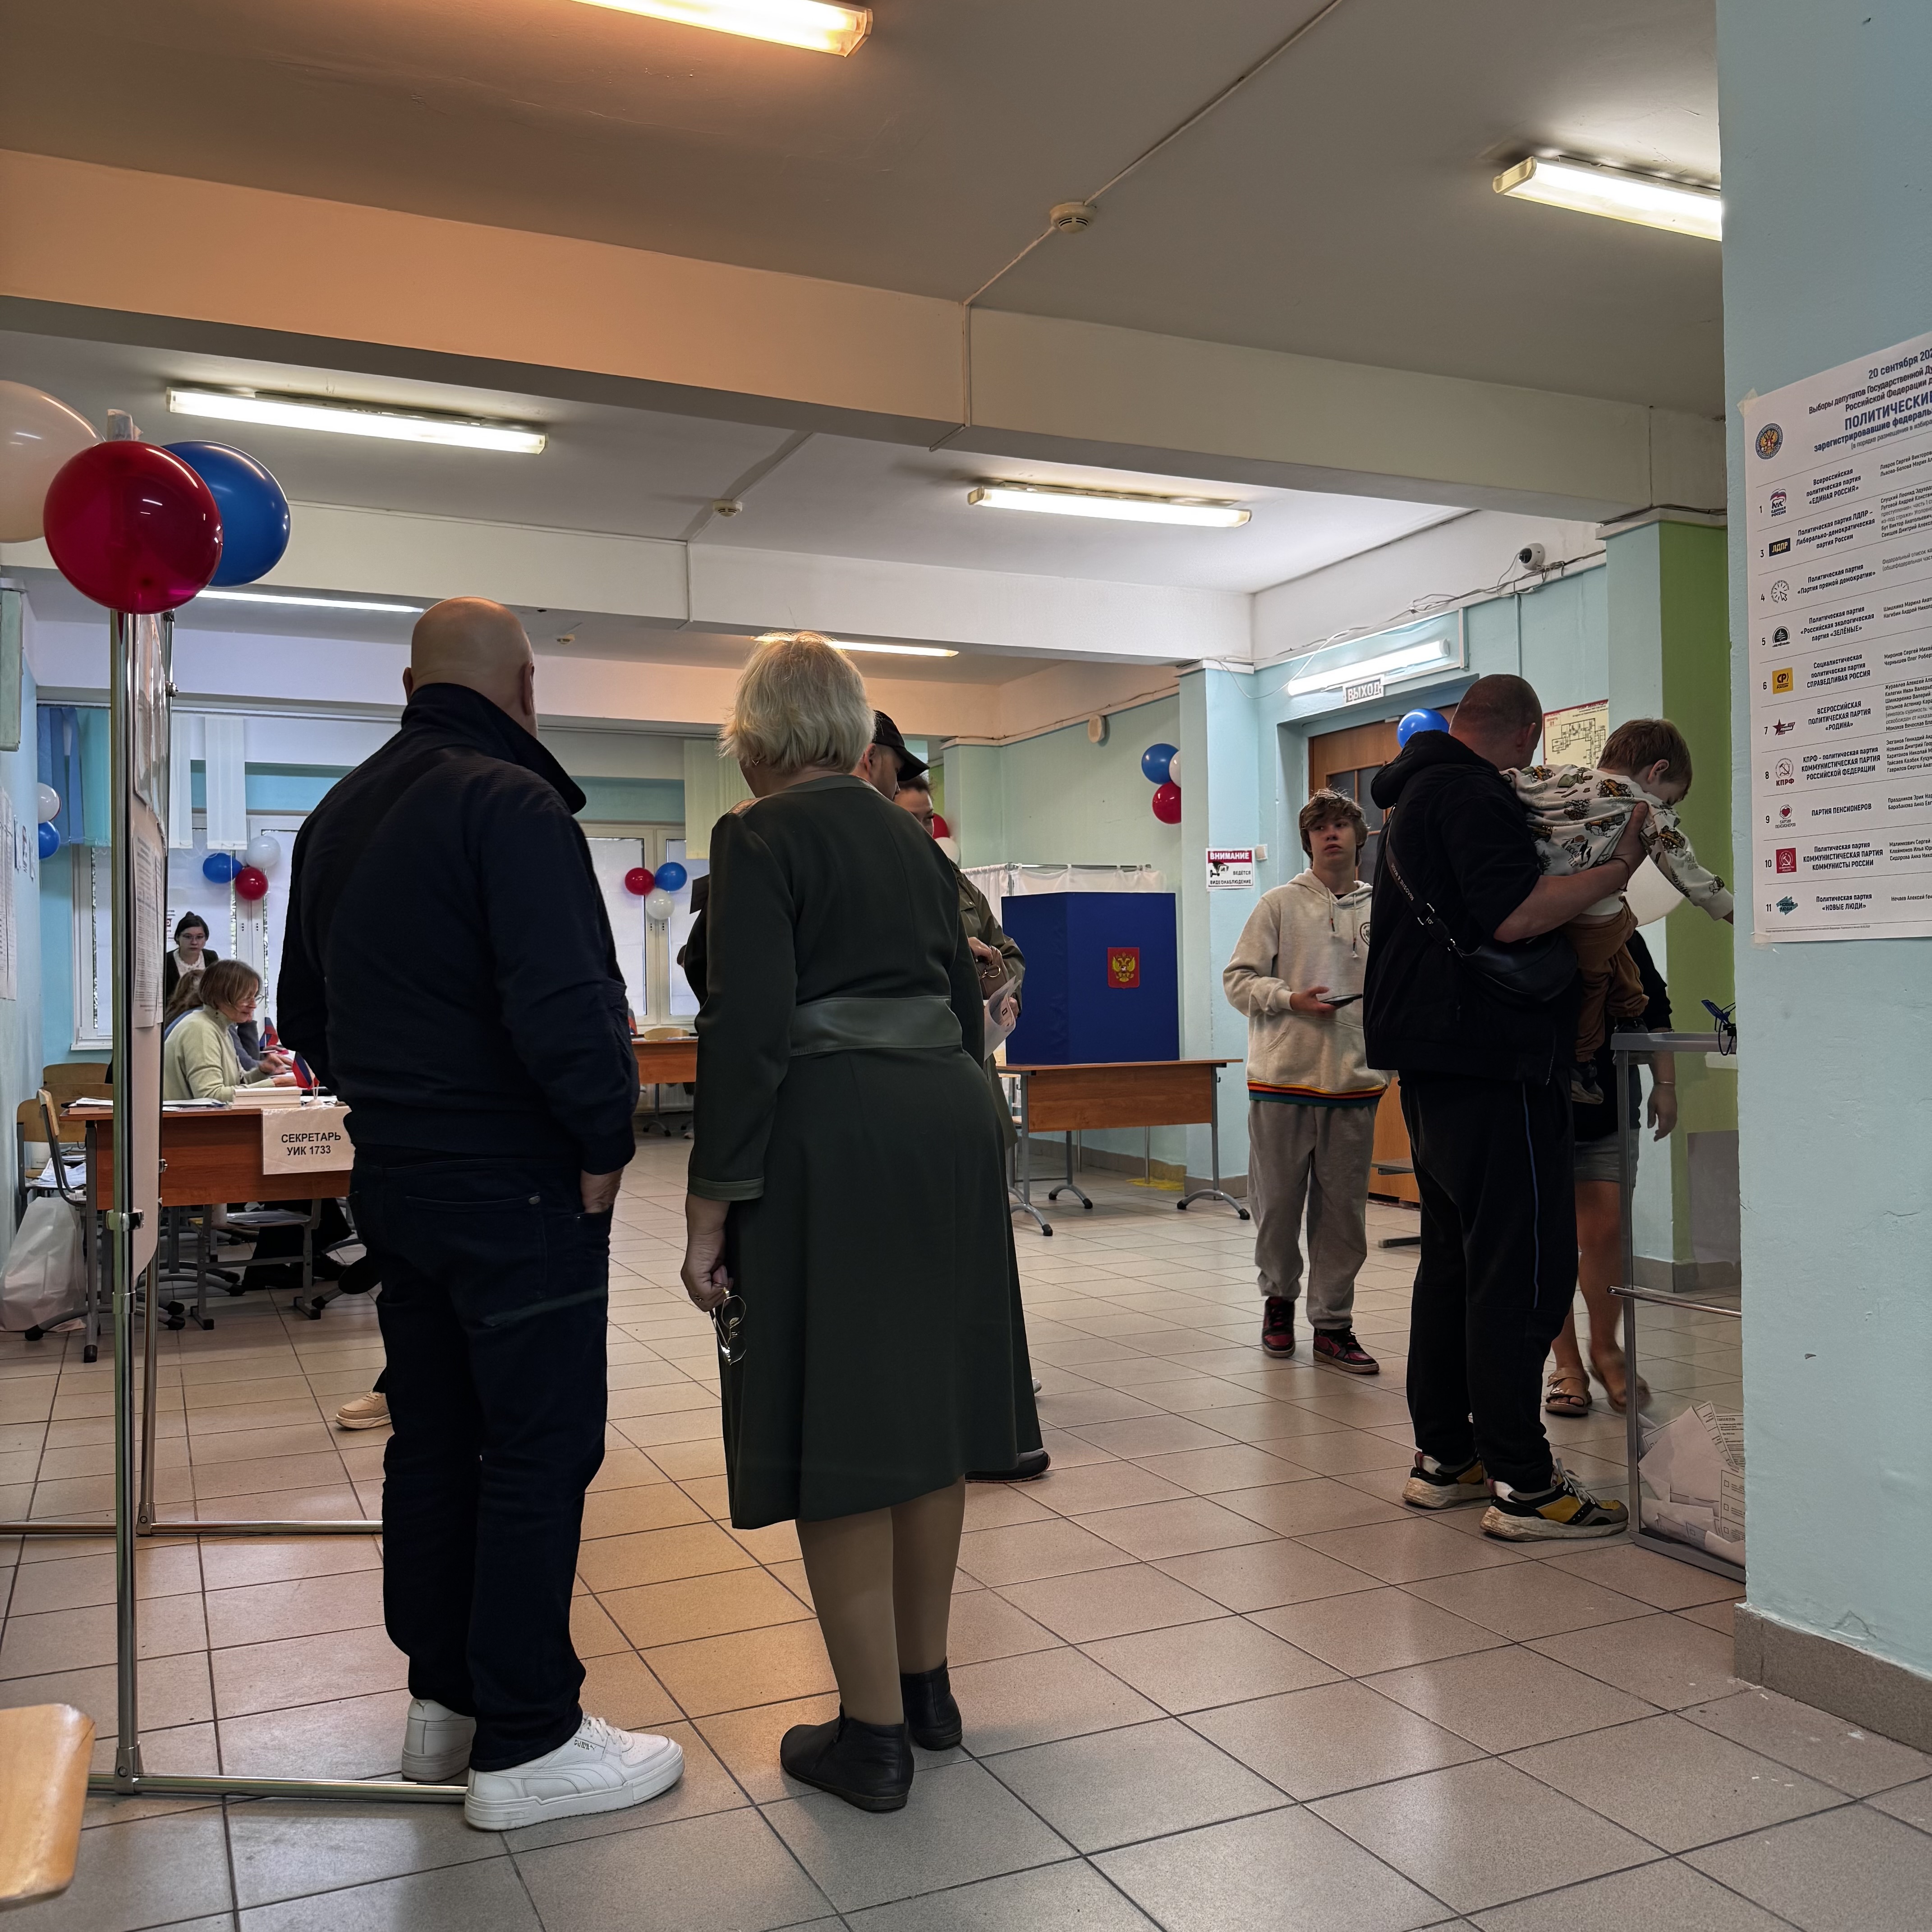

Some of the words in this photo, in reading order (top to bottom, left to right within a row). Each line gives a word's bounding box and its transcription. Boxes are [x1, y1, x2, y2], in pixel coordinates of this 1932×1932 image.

[1868, 368, 1878, 379] 20
[1880, 355, 1918, 375] сентября
[1809, 400, 1833, 414] Выборы
[1834, 389, 1866, 406] депутатов
[1867, 367, 1923, 394] Государственной
[1845, 391, 1885, 412] Российской
[1886, 379, 1927, 398] Федерации
[1814, 421, 1891, 452] зарегистрировавшие
[1892, 407, 1932, 428] федераль
[1813, 469, 1853, 486] Всероссийская
[1806, 481, 1842, 497] политическая
[1843, 475, 1861, 486] партия
[1809, 492, 1833, 504] «ЕДИНАЯ
[1834, 485, 1859, 497] РОССИЯ»
[1759, 506, 1762, 514] 1
[1798, 521, 1833, 536] Политическая
[1834, 516, 1852, 526] партия
[1853, 510, 1868, 520] ЛДПР
[1796, 519, 1875, 546] Либерально-демократическая
[1772, 543, 1788, 553] ЛДПР
[1816, 539, 1834, 549] партия
[1835, 534, 1854, 544] России
[1760, 549, 1764, 558] 3
[1808, 569, 1844, 583] Политическая
[1845, 564, 1863, 574] партия
[1797, 585, 1818, 594] «Партия
[1819, 579, 1839, 590] прямой
[1839, 571, 1876, 585] демократии»
[1761, 593, 1765, 602] 4
[1809, 611, 1845, 624] Политическая
[1846, 607, 1865, 616] партия
[1800, 623, 1834, 634] «Российская
[1834, 613, 1874, 627] экологическая
[1812, 633, 1829, 642] партия
[1830, 625, 1862, 636] «ЗЕЛЁНЫЕ»
[1762, 637, 1766, 646] 5
[1813, 654, 1862, 669] Социалистическая
[1811, 667, 1846, 678] политическая
[1847, 662, 1866, 671] партия
[1763, 681, 1767, 690] 6
[1807, 674, 1848, 688] СПРАВЕДЛИВАЯ
[1849, 670, 1870, 680] РОССИЯ
[1348, 681, 1382, 701] ВЫХОД
[1817, 700, 1861, 715] ВСЕРОССИЙСКАЯ
[1808, 712, 1849, 725] ПОЛИТИЧЕСКАЯ
[1850, 708, 1871, 718] ПАРТИЯ
[1764, 726, 1768, 735] 7
[1825, 721, 1853, 731] «РОДИНА»
[1803, 754, 1818, 763] КПРФ
[1822, 750, 1859, 760] политическая
[1860, 747, 1878, 755] партия
[1801, 758, 1858, 773] КОММУНИСТИЧЕСКАЯ
[1859, 754, 1881, 764] ПАРТИЯ
[1765, 771, 1769, 779] 8
[1807, 768, 1841, 781] РОССИЙСКОЙ
[1842, 764, 1876, 776] ФЕДЕРАЦИИ
[1776, 778, 1794, 786] КПРФ
[1812, 808, 1832, 816] ПАРТИЯ
[1833, 803, 1872, 814] ПЕНСИОНЕРОВ
[1766, 815, 1770, 823] 9
[1803, 851, 1860, 863] КОММУНИСТИЧЕСКАЯ
[1861, 849, 1883, 857] ПАРТИЯ
[1814, 844, 1851, 853] Политическая
[1765, 859, 1772, 868] 10
[1812, 861, 1850, 871] КОММУНИСТЫ
[1851, 859, 1874, 867] РОССИИ
[1766, 903, 1771, 912] 11
[281, 1132, 341, 1143] СЕКРЕТАРЬ
[287, 1146, 307, 1156] УИК
[309, 1145, 331, 1155] 1733
